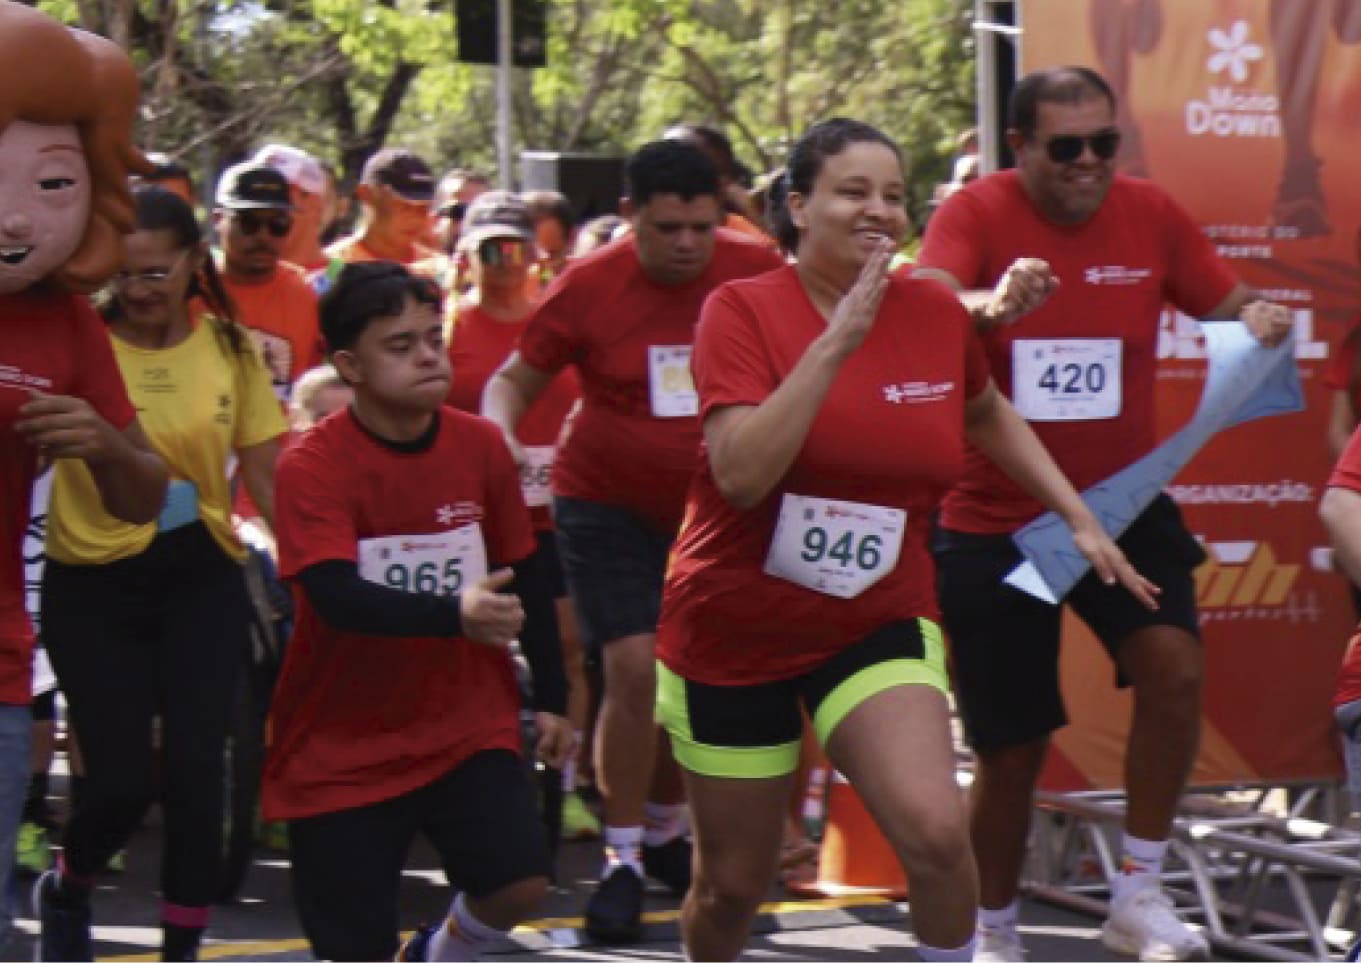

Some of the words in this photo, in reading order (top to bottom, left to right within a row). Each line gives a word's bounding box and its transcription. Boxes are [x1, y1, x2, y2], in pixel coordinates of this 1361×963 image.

[1184, 99, 1281, 137] Down
[1038, 362, 1106, 394] 420
[801, 526, 883, 570] 946
[385, 558, 463, 594] 965
